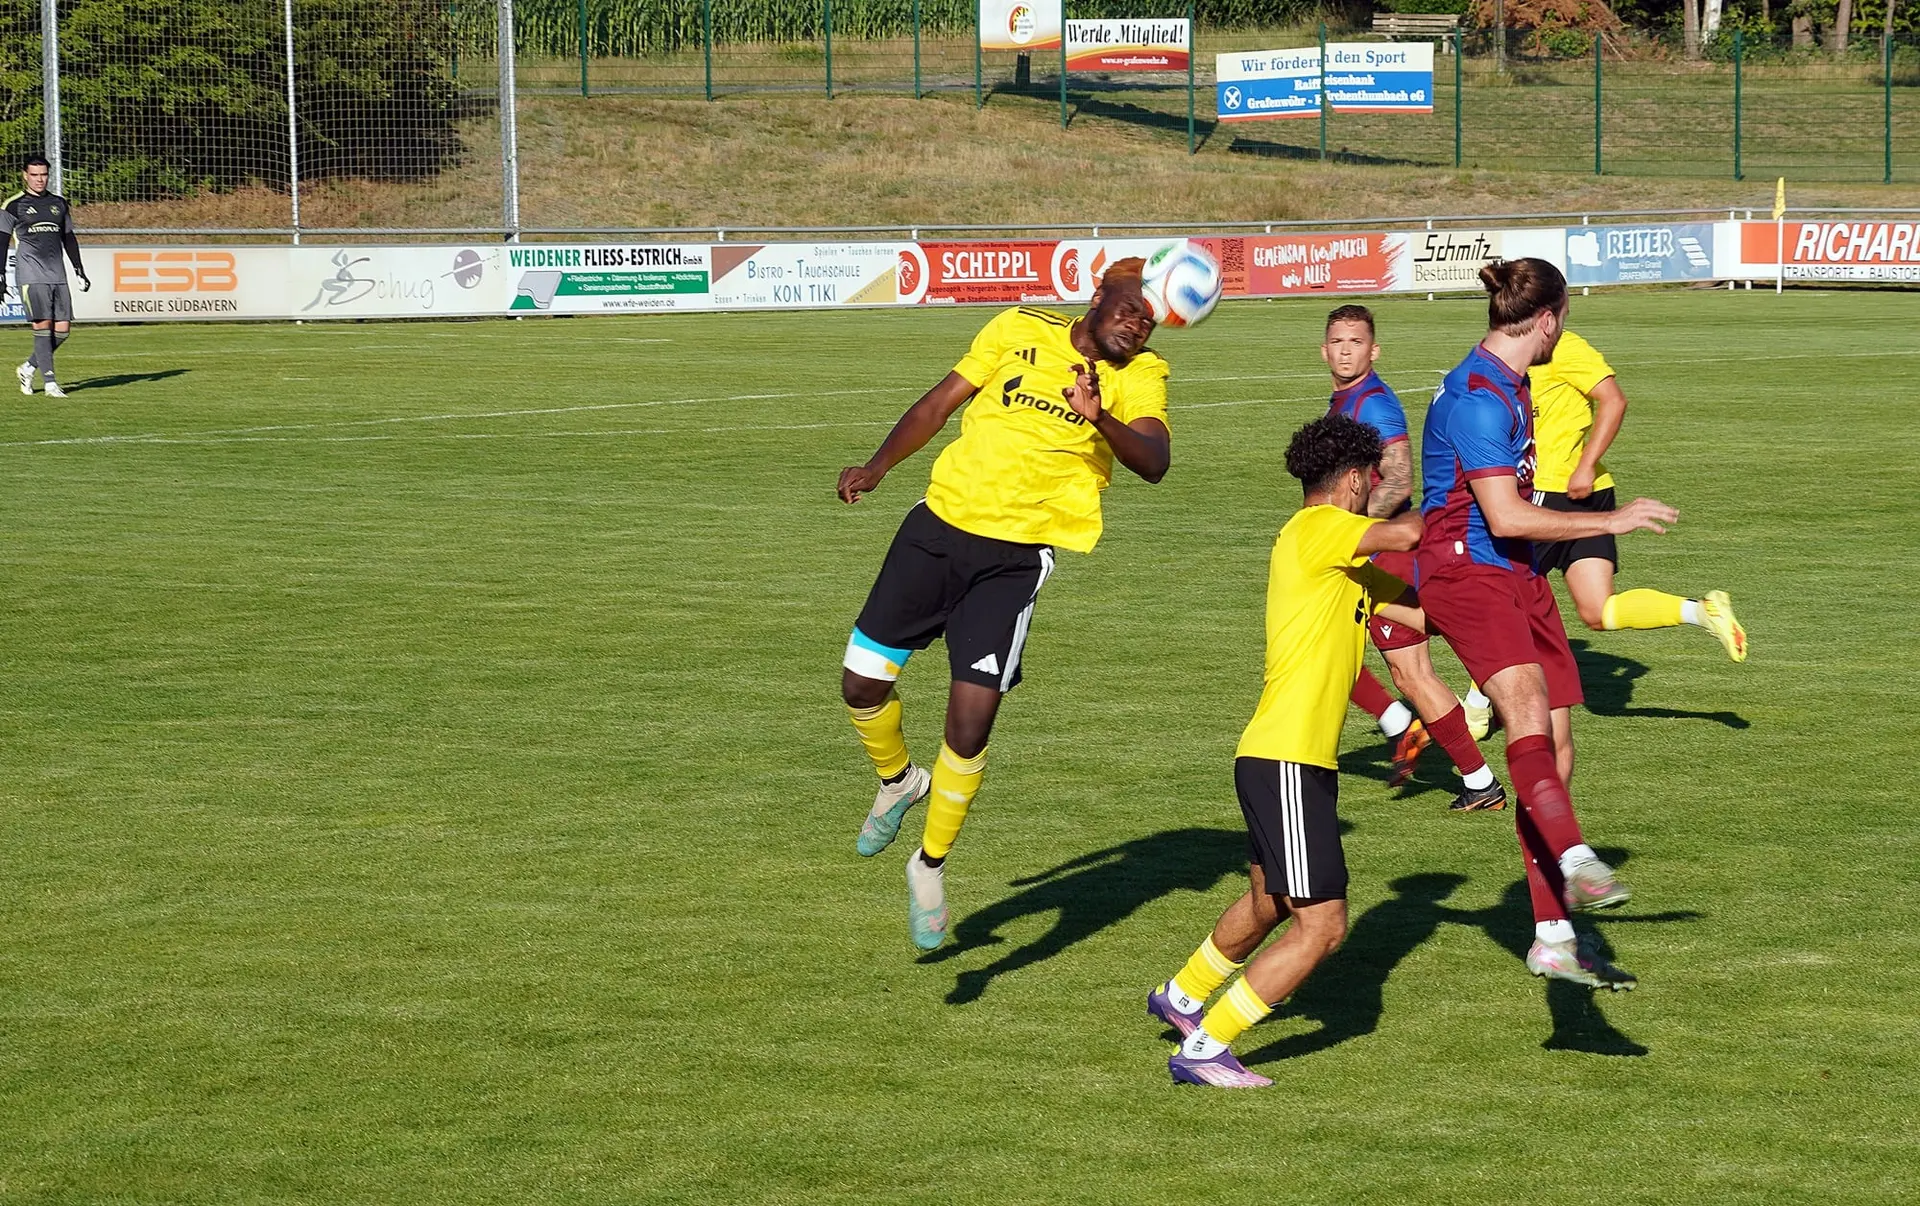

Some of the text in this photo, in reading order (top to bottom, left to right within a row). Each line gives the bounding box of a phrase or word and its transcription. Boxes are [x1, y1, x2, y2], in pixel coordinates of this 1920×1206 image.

[1068, 24, 1184, 46] Werde Mitglied!
[1241, 59, 1266, 72] Wir
[1335, 50, 1360, 63] den
[1366, 50, 1406, 67] Sport
[1247, 95, 1306, 109] Grafenwöhr
[1410, 90, 1425, 101] eG
[1414, 233, 1502, 262] Schmitz
[1608, 230, 1673, 258] REITER
[509, 248, 703, 267] WEIDENER FLIESS-ESTRICH GmbH
[942, 252, 1037, 278] SCHIPPL
[1254, 244, 1308, 267] GEMEINSAM
[114, 252, 237, 292] ESB
[748, 261, 783, 278] BISTRO
[797, 259, 860, 278] TAUCHSCHULE
[1304, 263, 1331, 285] ALLES
[1786, 266, 1920, 279] TRANSPORTE BAUSTOF
[328, 256, 435, 309] Schug
[773, 284, 802, 302] KON
[809, 284, 836, 302] TIKI
[114, 297, 238, 313] ENERGIE SÜDBAYERN
[603, 299, 675, 308] www.wfe-weiden.de
